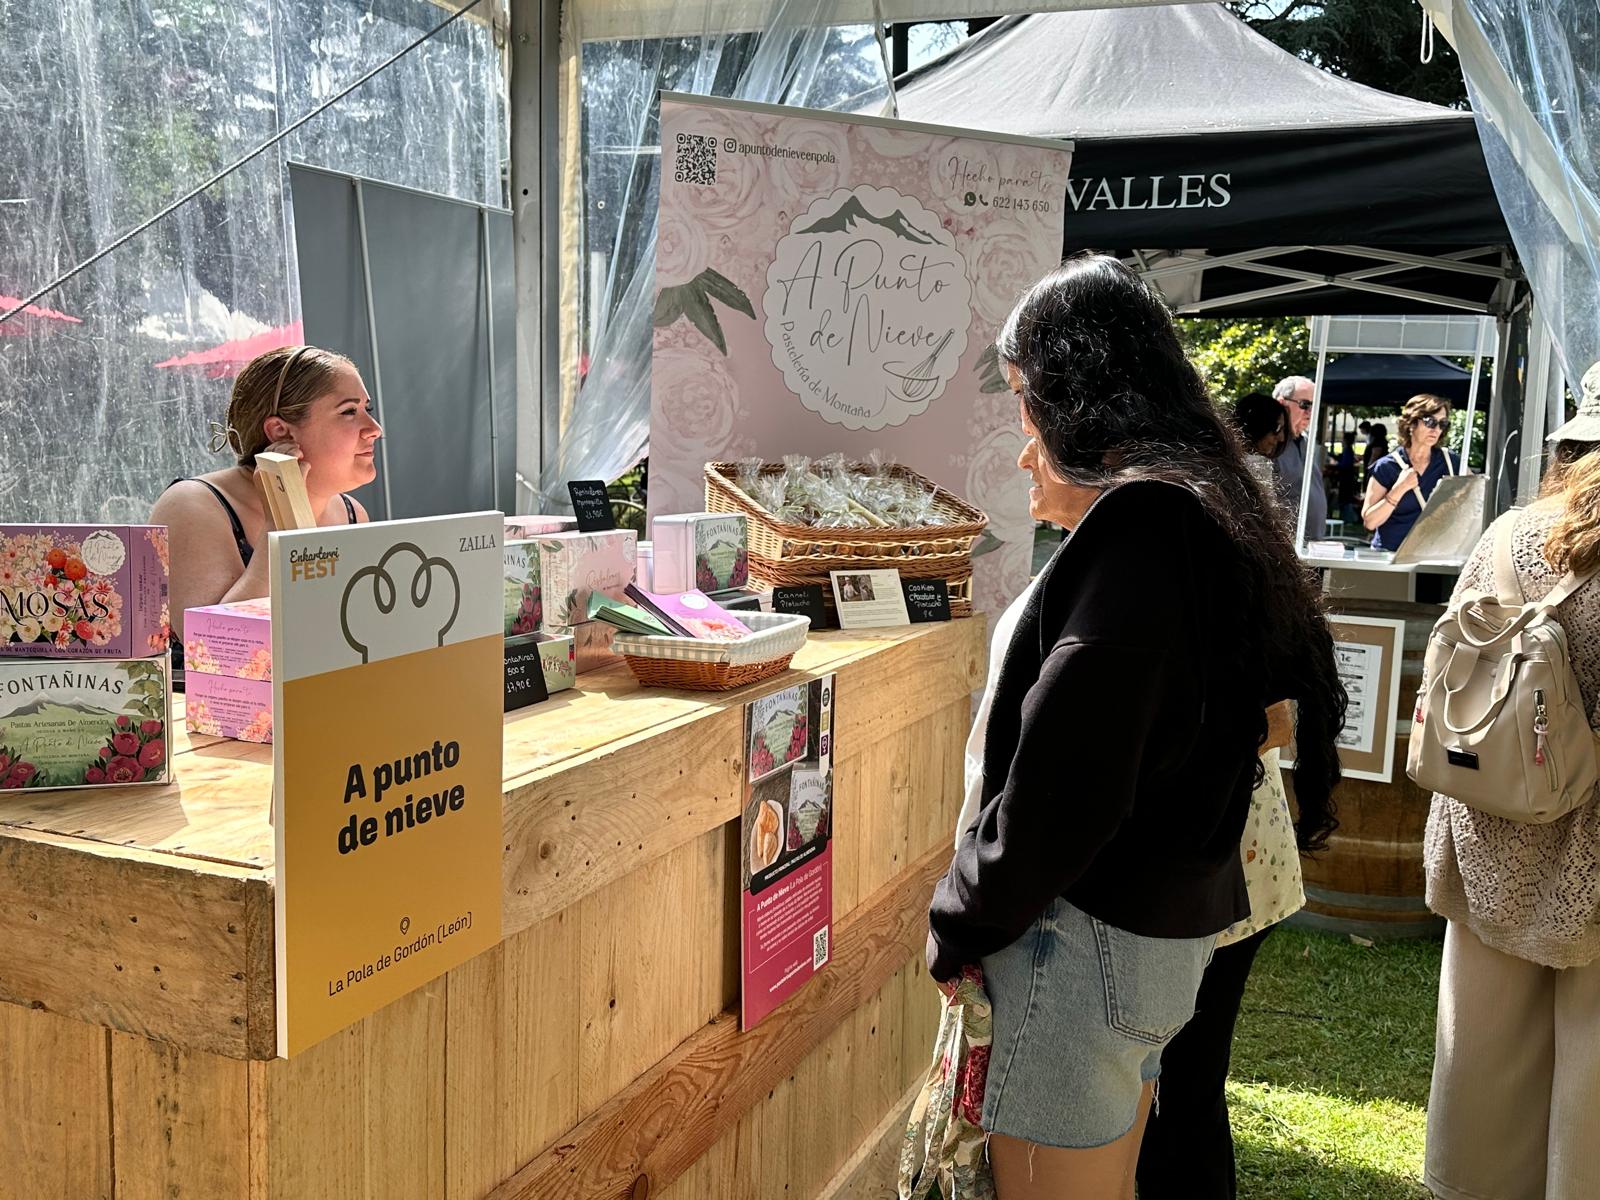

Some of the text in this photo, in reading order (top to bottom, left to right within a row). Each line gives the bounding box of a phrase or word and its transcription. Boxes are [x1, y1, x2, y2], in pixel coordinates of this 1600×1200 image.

[738, 142, 836, 164] apuntodenieveenpola
[992, 196, 1050, 212] 622 143 650
[1066, 173, 1231, 211] VALLES
[776, 239, 955, 316] A Punto
[809, 293, 943, 366] de Nieve
[780, 321, 871, 418] Pastelería de Montaña
[290, 546, 340, 563] Enkarterri
[459, 534, 496, 553] ZALLA
[291, 557, 337, 582] FEST
[10, 721, 31, 729] Pastas
[33, 720, 66, 728] Artesanas
[343, 740, 460, 804] A punto
[337, 784, 465, 855] de nieve
[328, 911, 473, 997] La Pola de Gordón (León)
